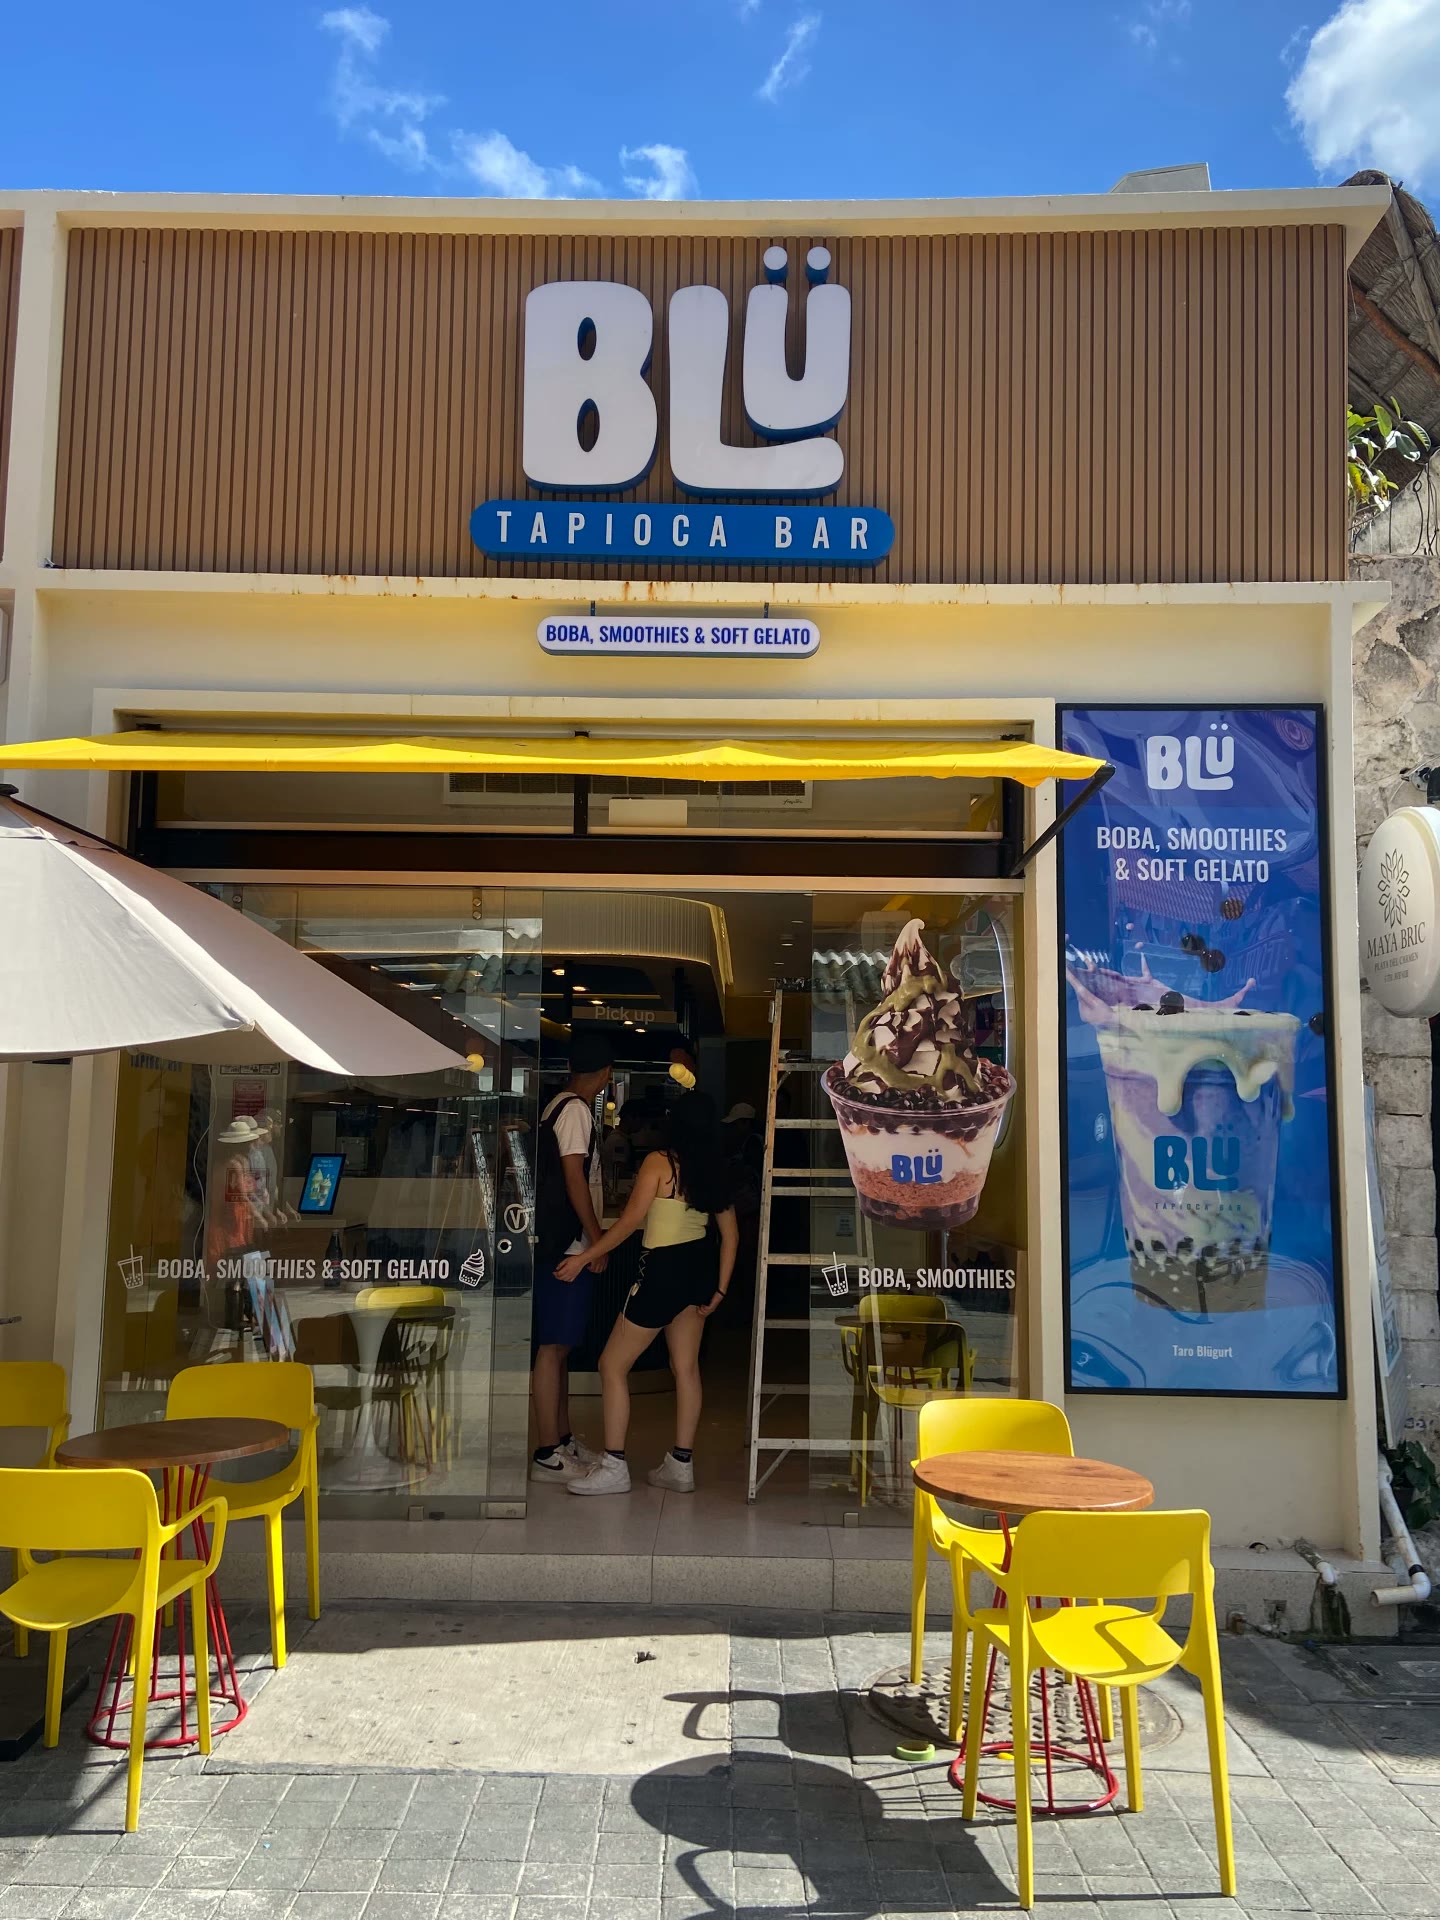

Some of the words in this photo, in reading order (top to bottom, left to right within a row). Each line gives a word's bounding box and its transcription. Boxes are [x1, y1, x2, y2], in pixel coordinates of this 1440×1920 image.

[522, 246, 852, 498] BLÜ
[497, 511, 728, 547] TAPIOCA
[775, 517, 868, 550] BAR
[545, 624, 595, 645] BOBA,
[599, 626, 689, 645] SMOOTHIES
[694, 627, 706, 645] &
[711, 627, 749, 645] SOFT
[753, 628, 811, 646] GELATO
[1147, 723, 1235, 791] BLÜ
[1097, 826, 1160, 852] BOBA,
[1167, 827, 1287, 852] SMOOTHIES
[1115, 859, 1131, 881] &
[1137, 858, 1187, 882] SOFT
[1194, 859, 1269, 883] GELATO
[1367, 932, 1398, 959] MAYA
[1400, 921, 1426, 949] BRIC
[594, 1006, 630, 1021] Pick
[634, 1009, 656, 1025] up
[891, 1148, 943, 1184] BLÜ
[1153, 1123, 1241, 1191] BLÜ
[157, 1259, 210, 1280] BOBA,
[216, 1258, 316, 1279] SMOOTHIES
[321, 1258, 334, 1279] &
[340, 1259, 383, 1279] SOFT
[387, 1259, 450, 1279] GELATO
[858, 1267, 911, 1290] BOBA,
[916, 1268, 1016, 1290] SMOOTHIES
[1172, 1344, 1194, 1358] Taro
[1196, 1345, 1233, 1361] Blügurt
